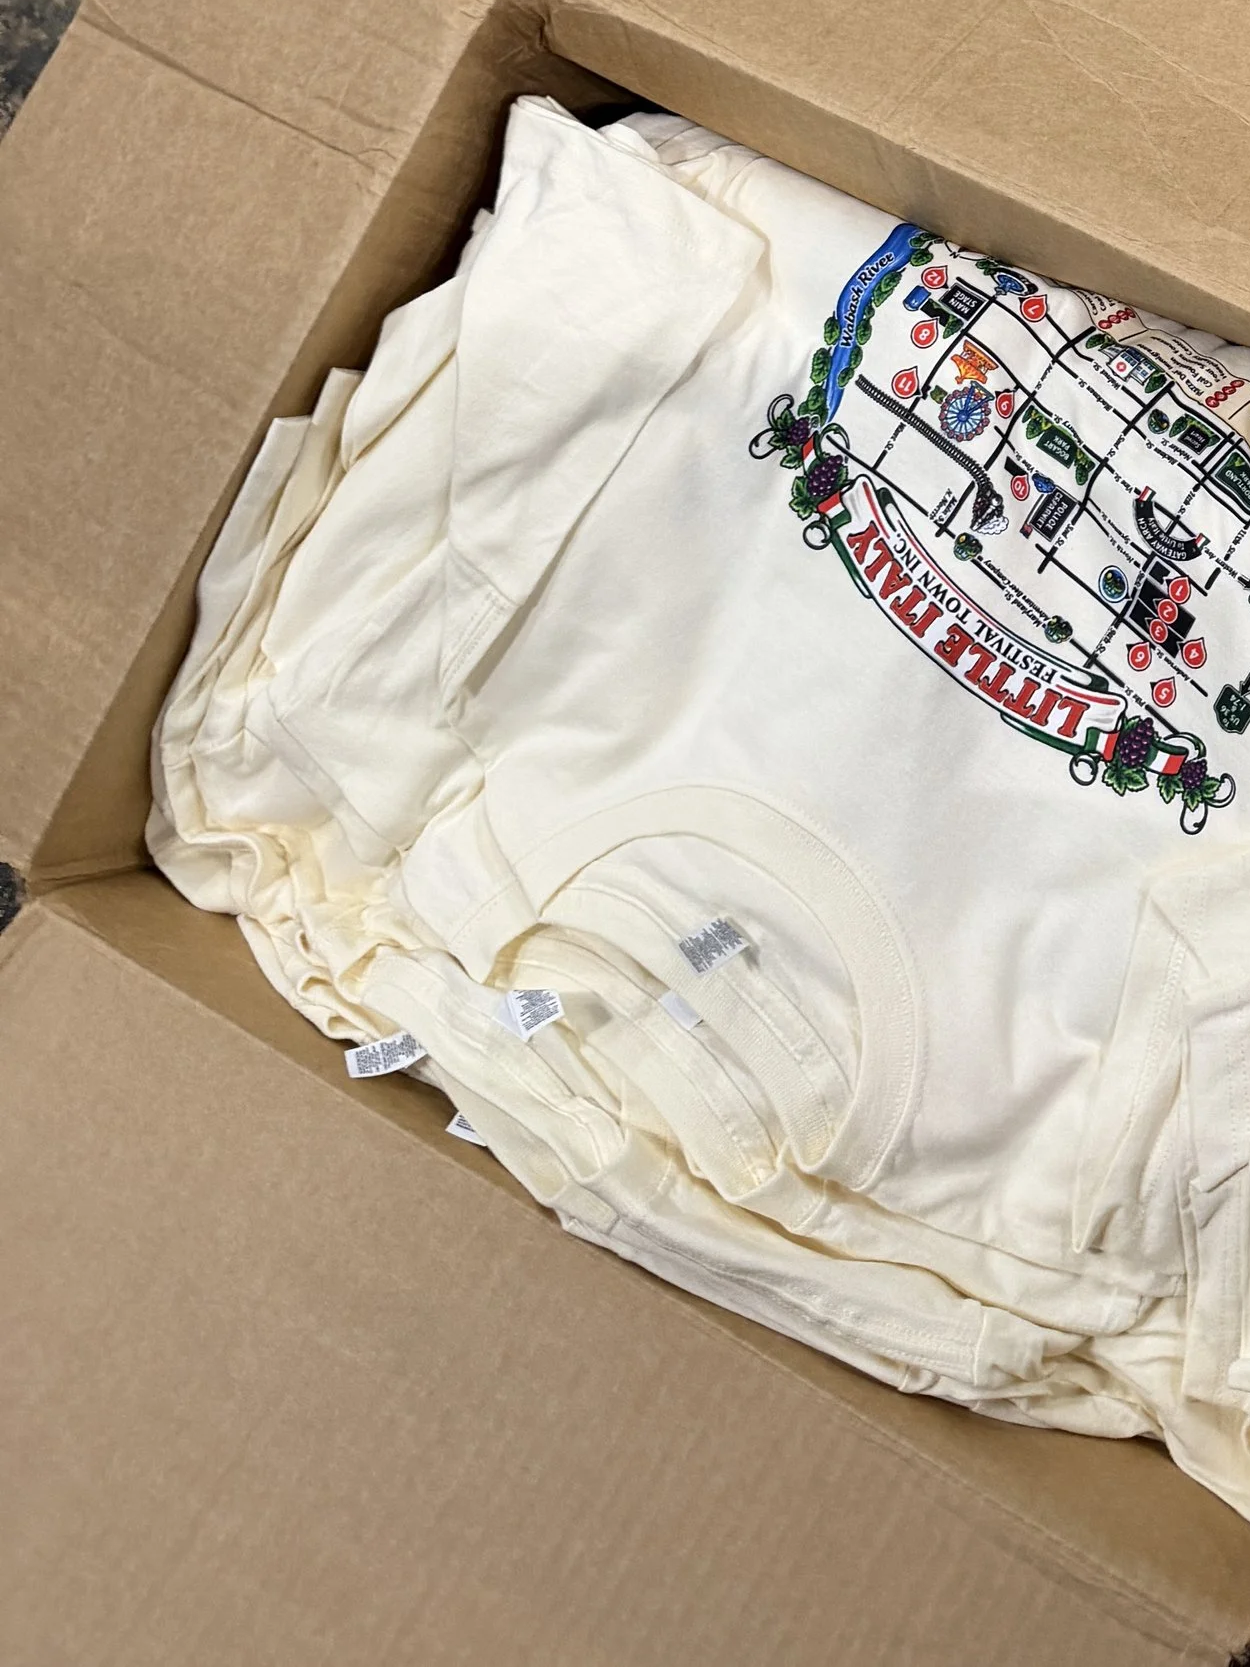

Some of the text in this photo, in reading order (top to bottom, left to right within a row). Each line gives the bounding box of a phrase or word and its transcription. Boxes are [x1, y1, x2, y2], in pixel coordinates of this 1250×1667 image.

[927, 271, 942, 285] 12
[948, 297, 971, 314] MAIN
[955, 290, 978, 310] STAGE
[1028, 304, 1039, 314] 7
[841, 286, 863, 348] Wabash
[918, 328, 928, 340] 8
[1093, 361, 1121, 390] Walnut St.
[1197, 376, 1212, 388] Coal
[1205, 368, 1220, 383] Four
[899, 377, 912, 392] 11
[1077, 377, 1088, 390] St.
[1001, 401, 1009, 411] 9
[1052, 413, 1065, 427] St.
[1042, 439, 1071, 462] BOGART
[1052, 434, 1071, 452] PARK
[1015, 480, 1026, 494] 10
[1112, 472, 1134, 494] Vine St.
[1044, 501, 1068, 531] POLICE
[1147, 517, 1161, 534] Italy
[1137, 517, 1187, 560] GATEWAY ARCH
[1159, 532, 1176, 548] Little
[1116, 546, 1134, 564] North
[1203, 546, 1239, 578] Western Ave.
[983, 559, 1011, 588] Company
[1175, 585, 1183, 597] 1
[892, 533, 1058, 685] FESTIVAL TOWN INC.
[1003, 589, 1043, 629] Maryland St.
[1163, 609, 1172, 618] 2
[846, 521, 1091, 739] LITTLE ITALY
[1155, 625, 1162, 637] 3
[1135, 652, 1145, 662] 6
[1189, 648, 1200, 660] 4
[1164, 656, 1191, 682] Anderson
[1125, 686, 1135, 696] St.
[1160, 687, 1170, 697] 5
[1222, 717, 1230, 728] To
[1230, 714, 1240, 726] US
